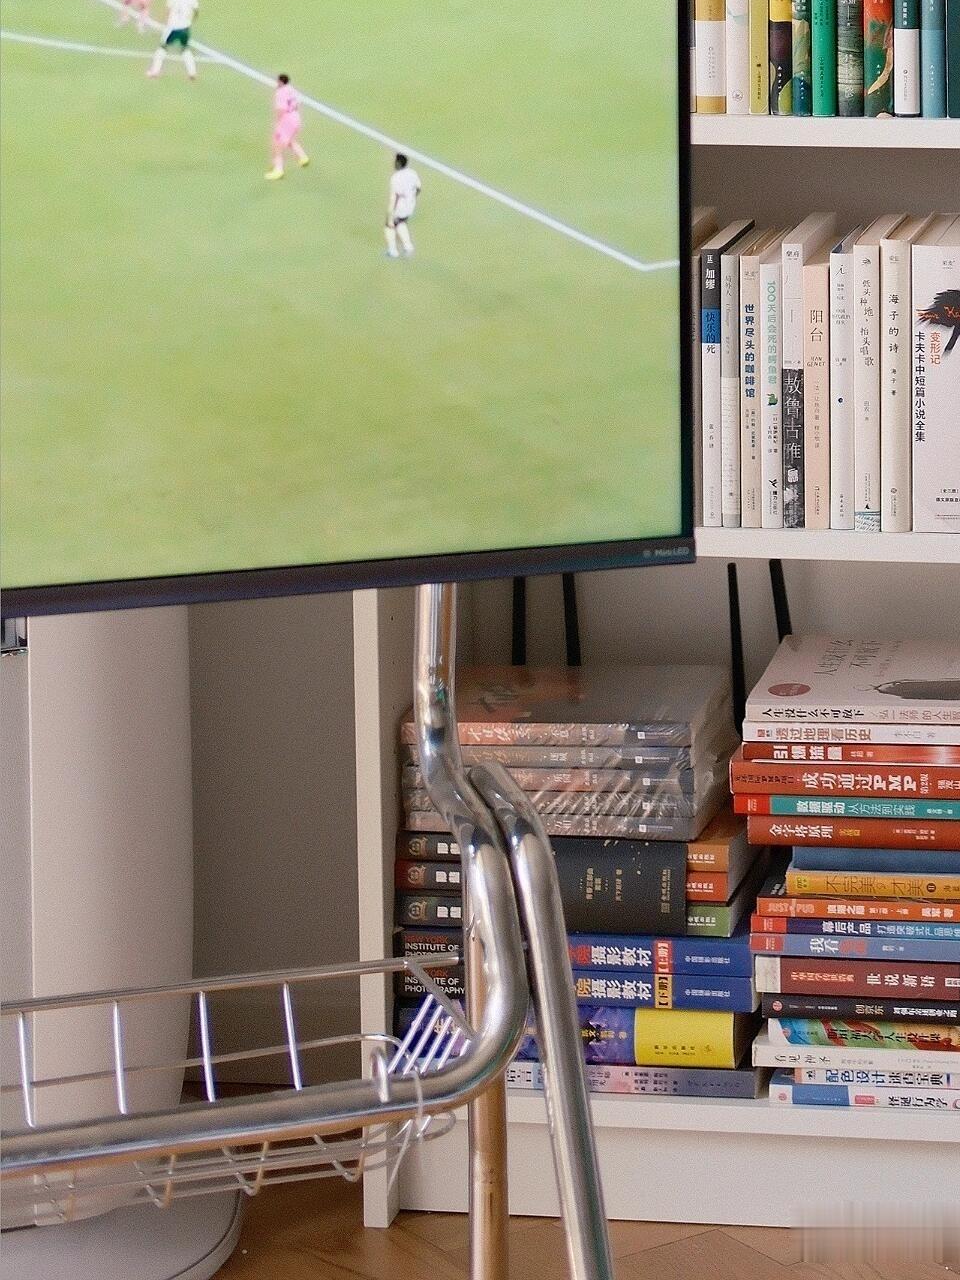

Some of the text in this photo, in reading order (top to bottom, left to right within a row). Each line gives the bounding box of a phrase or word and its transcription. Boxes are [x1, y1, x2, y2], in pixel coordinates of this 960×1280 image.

[705, 269, 715, 290] 加缪
[810, 309, 823, 343] 阳台
[888, 294, 900, 353] 海子的诗
[705, 312, 716, 354] 快乐的死
[744, 303, 756, 399] 世界尽头的咖啡馆
[930, 331, 941, 365] 变形记
[914, 331, 926, 442] 卡夫卡中短篇小说全集
[784, 376, 802, 464] 敖鲁古雅
[761, 708, 866, 720] 人生没什么不可放下
[775, 727, 872, 742] 透过地理看历史
[773, 745, 843, 761] 引爆流量
[802, 772, 918, 792] 成功通过PMP
[796, 800, 916, 816] 数据驱动 从方法到实践
[769, 823, 834, 839] 金字塔原理
[822, 920, 872, 935] 幕后产品
[404, 942, 460, 951] INSTITUTE OF
[448, 977, 460, 985] OF
[867, 973, 937, 988] 世说新语
[855, 1004, 885, 1016] 创京东
[828, 1028, 941, 1043] 斯坦福大学人生设计课
[825, 1069, 945, 1086] 配色设计速查宝典
[888, 1094, 949, 1108] 怪诞行为学
